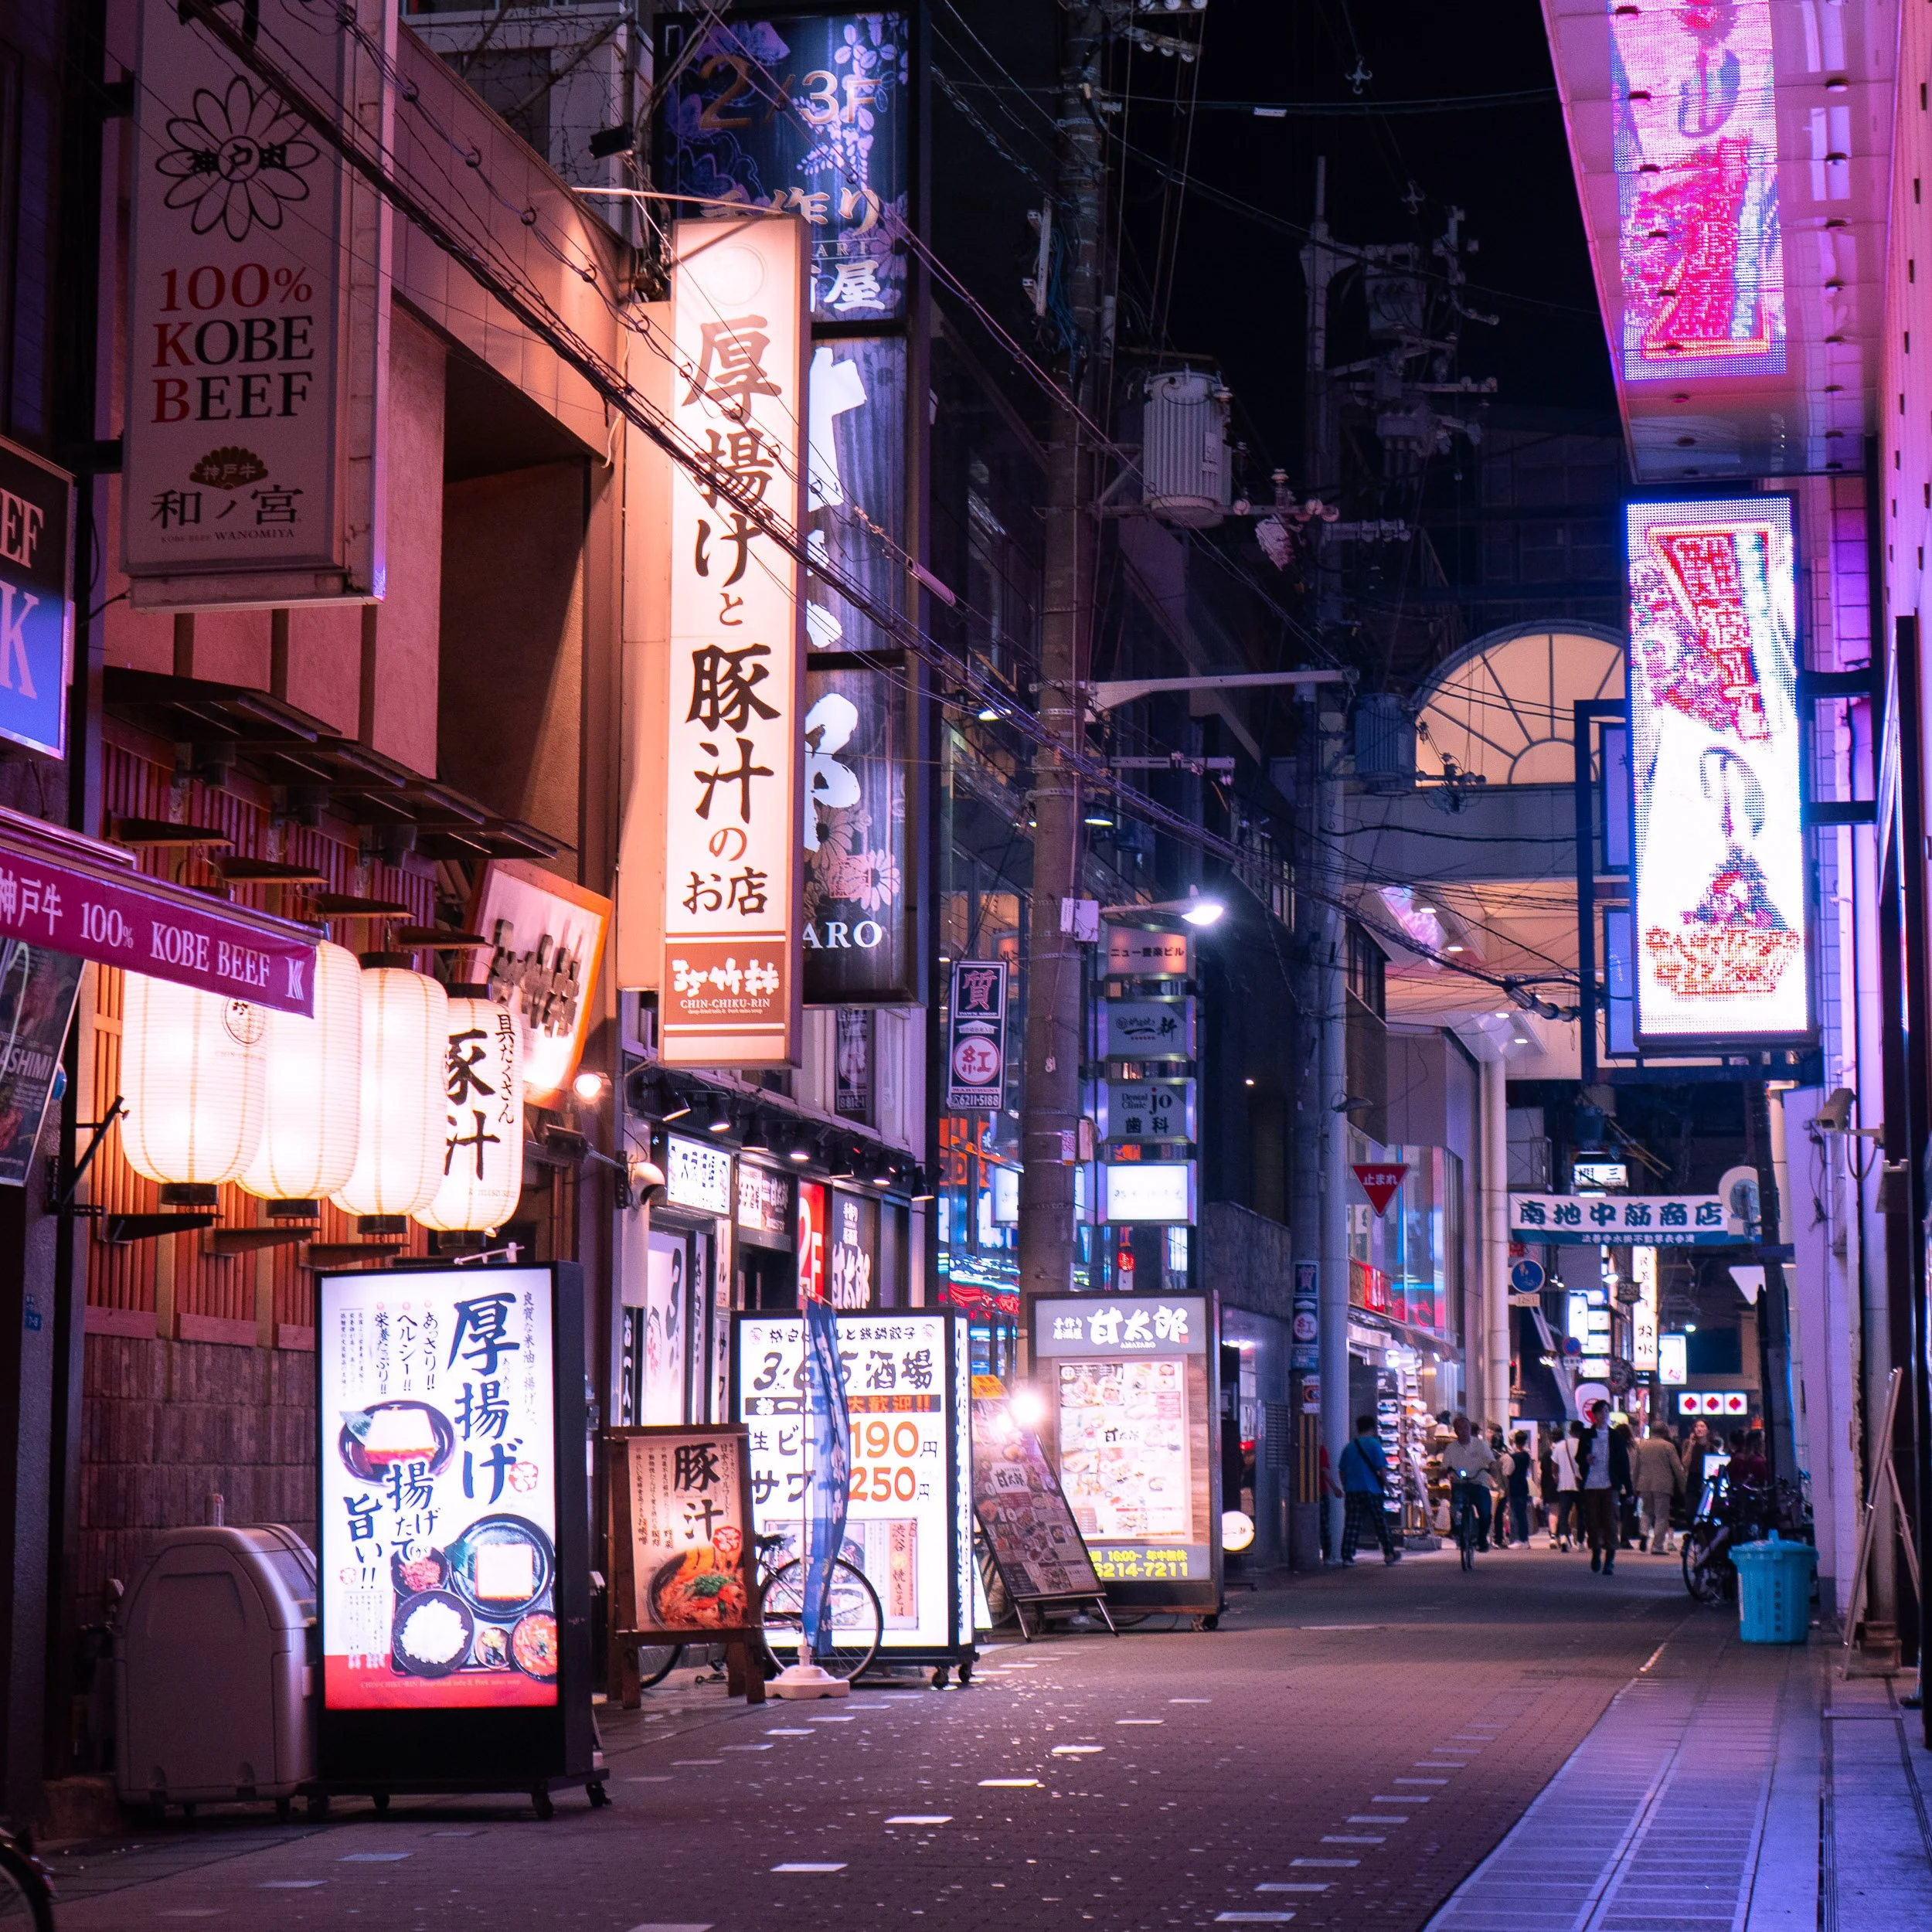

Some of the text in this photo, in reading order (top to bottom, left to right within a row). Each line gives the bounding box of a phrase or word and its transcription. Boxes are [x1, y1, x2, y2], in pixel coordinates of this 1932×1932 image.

[160, 263, 312, 311] 100%
[151, 315, 315, 368] KOBE
[151, 372, 313, 423] BEEF
[202, 463, 257, 481] 神戸牛
[214, 529, 294, 540] WANOMIYA
[80, 900, 134, 949] 100%
[150, 920, 210, 971] KOBE
[216, 939, 270, 988] BEEF
[680, 998, 770, 1009] CHIN-CHIKU-RIN
[962, 970, 998, 1011] 質
[961, 1044, 992, 1074] 紅
[1122, 1101, 1146, 1110] Clinic
[1125, 1117, 1169, 1134] 歯科
[1362, 1173, 1398, 1186] 止まれ
[1087, 1304, 1189, 1345] 甘太郎
[396, 1315, 418, 1392] ヘルシー!!
[447, 1292, 523, 1505] 厚揚げ
[674, 1442, 725, 1543] 豚汁
[343, 1493, 383, 1589] 旨い!!
